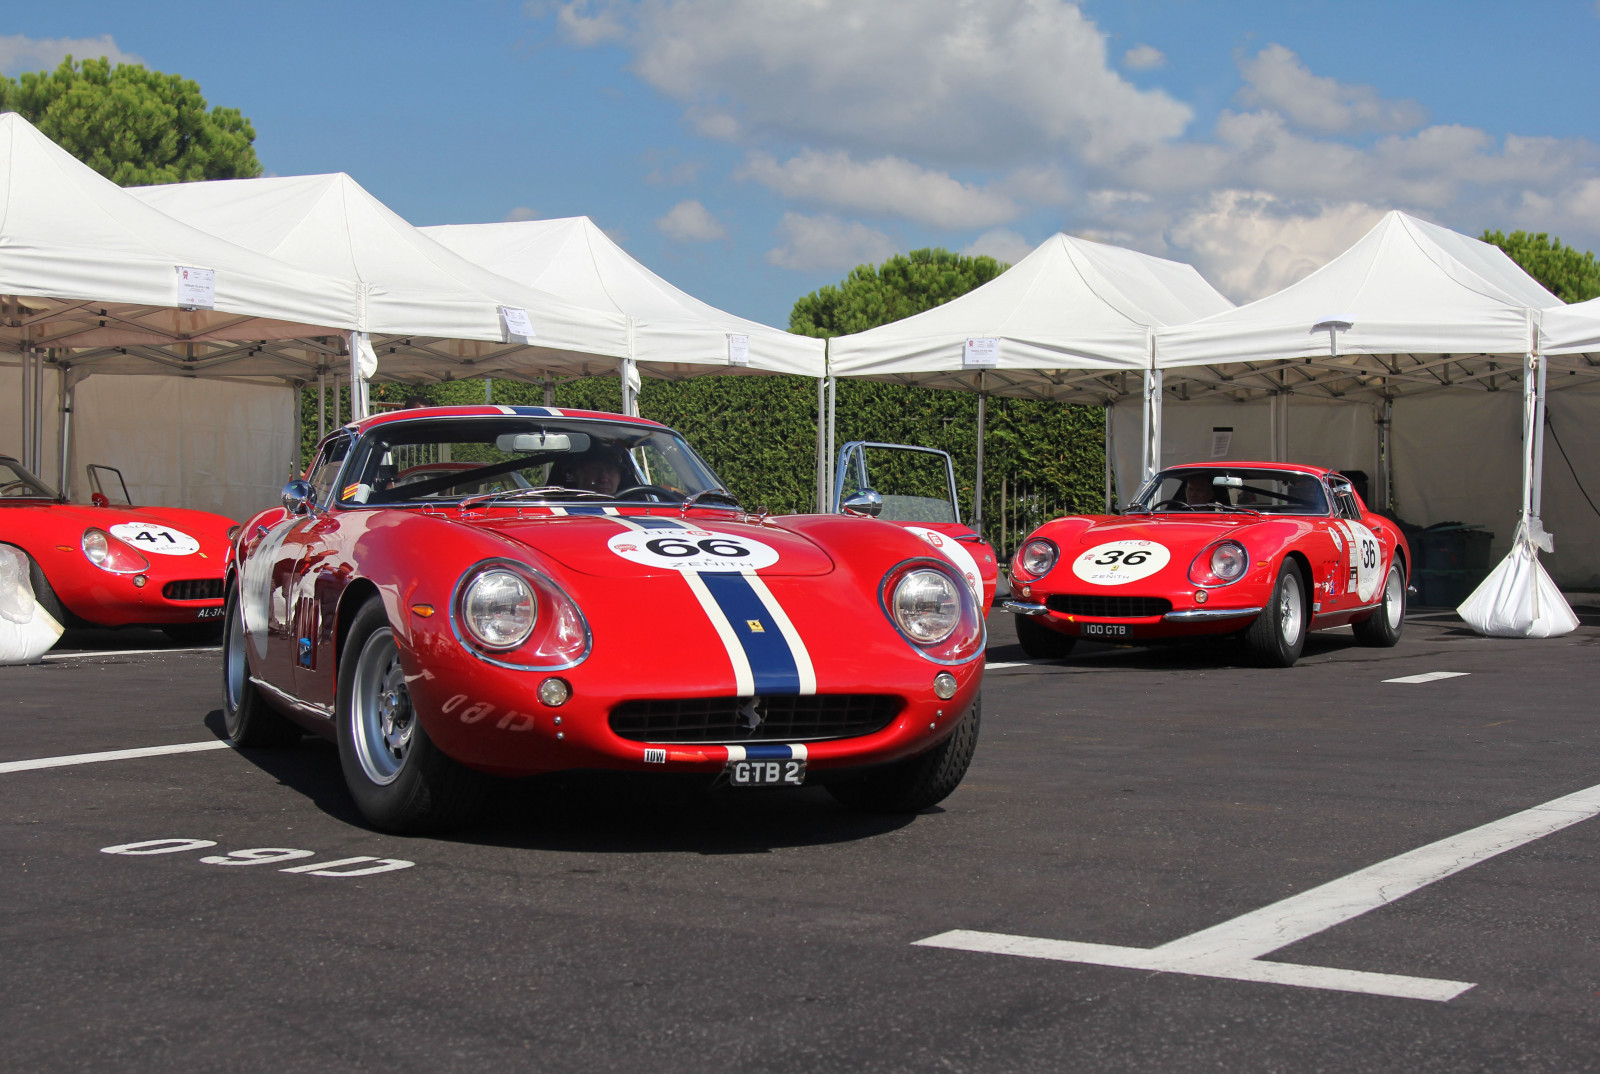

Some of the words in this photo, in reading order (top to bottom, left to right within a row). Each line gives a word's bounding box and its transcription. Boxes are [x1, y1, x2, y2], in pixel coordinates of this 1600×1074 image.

[135, 531, 176, 544] 41
[645, 537, 751, 558] 66
[1362, 539, 1376, 569] 36
[1095, 550, 1152, 566] 36
[1086, 624, 1104, 635] 100
[1105, 625, 1126, 636] GTB
[645, 749, 665, 764] TOW
[735, 762, 780, 784] GTB
[784, 761, 801, 783] 2
